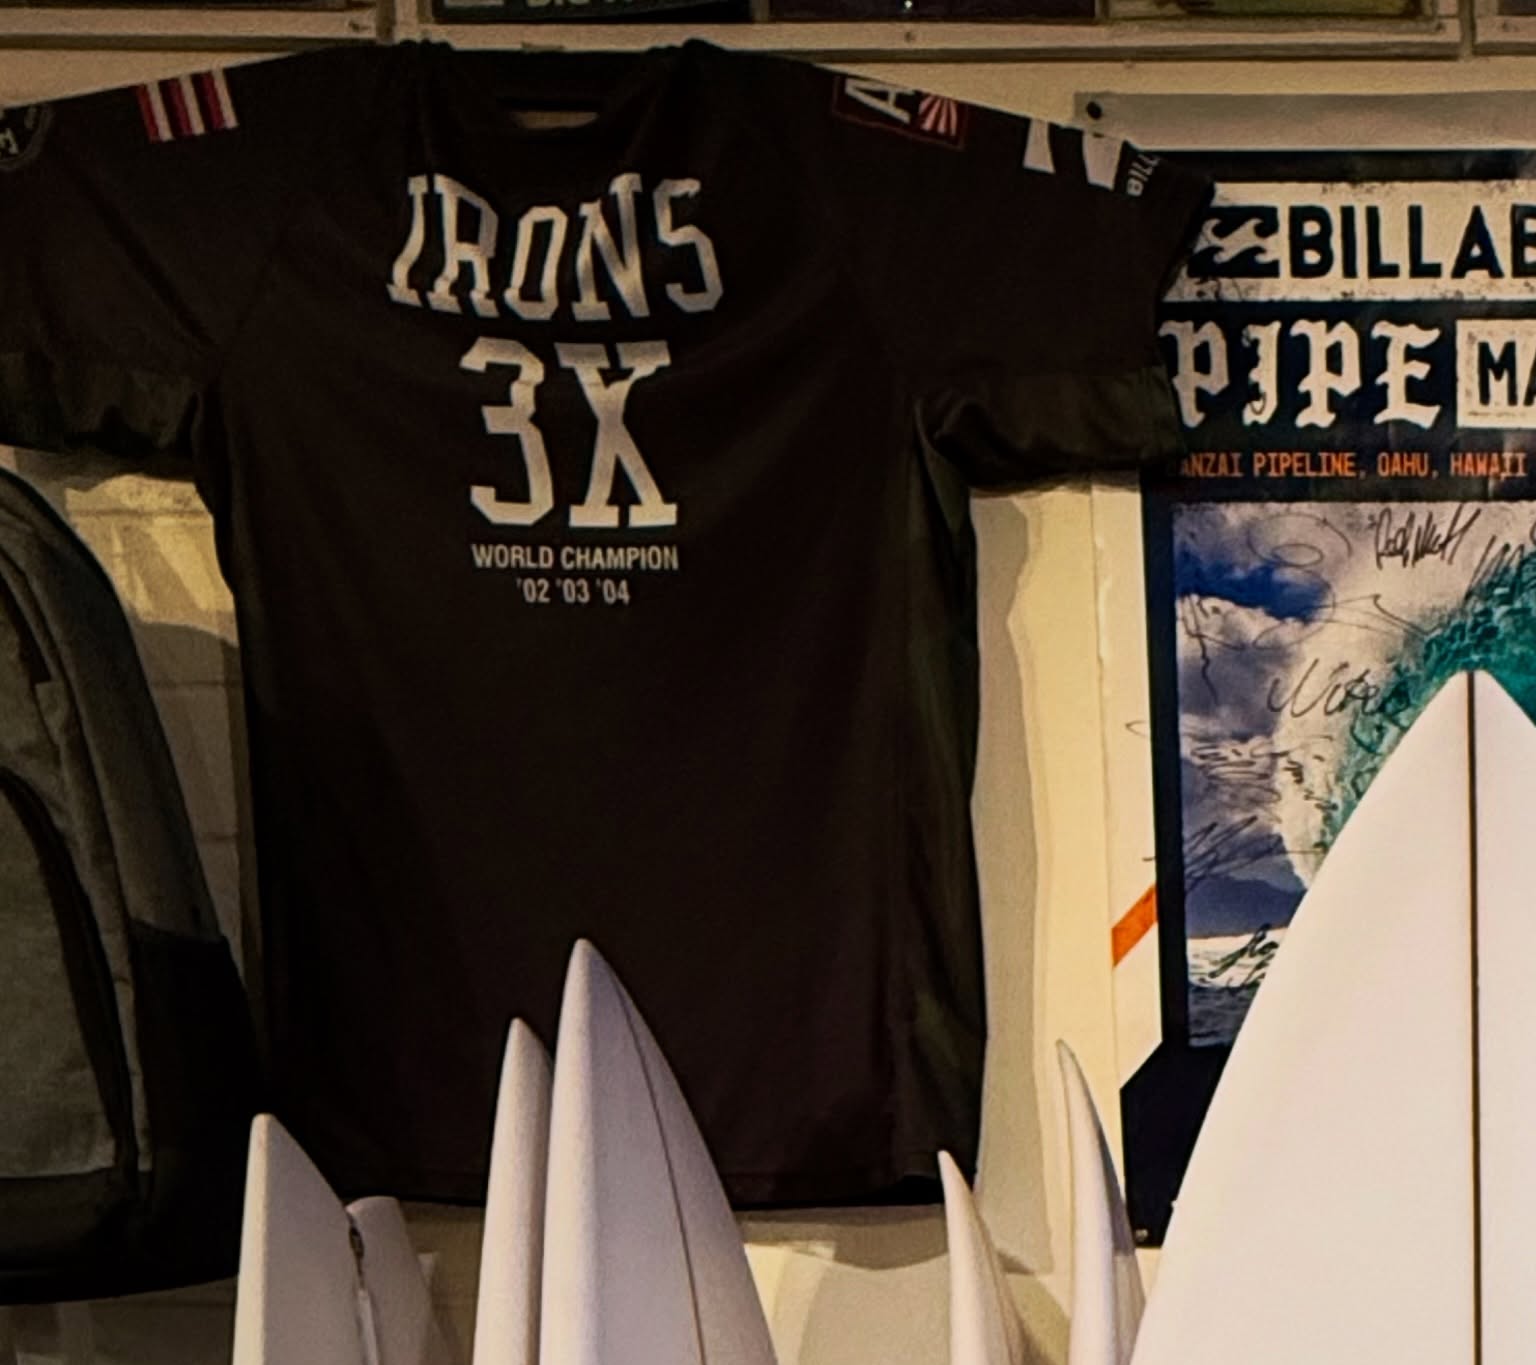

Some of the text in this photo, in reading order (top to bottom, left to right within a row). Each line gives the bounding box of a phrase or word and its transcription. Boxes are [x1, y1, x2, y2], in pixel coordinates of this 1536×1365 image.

[387, 172, 723, 320] IRONS
[1159, 319, 1442, 429] PIPE
[459, 337, 677, 527] 3X
[1252, 452, 1366, 480] PIPELINE,
[1377, 452, 1437, 480] OAHU,
[1450, 452, 1528, 477] HAWAII
[471, 543, 679, 570] WORLD CHAMPION
[516, 577, 631, 605] '02 '03 '04
